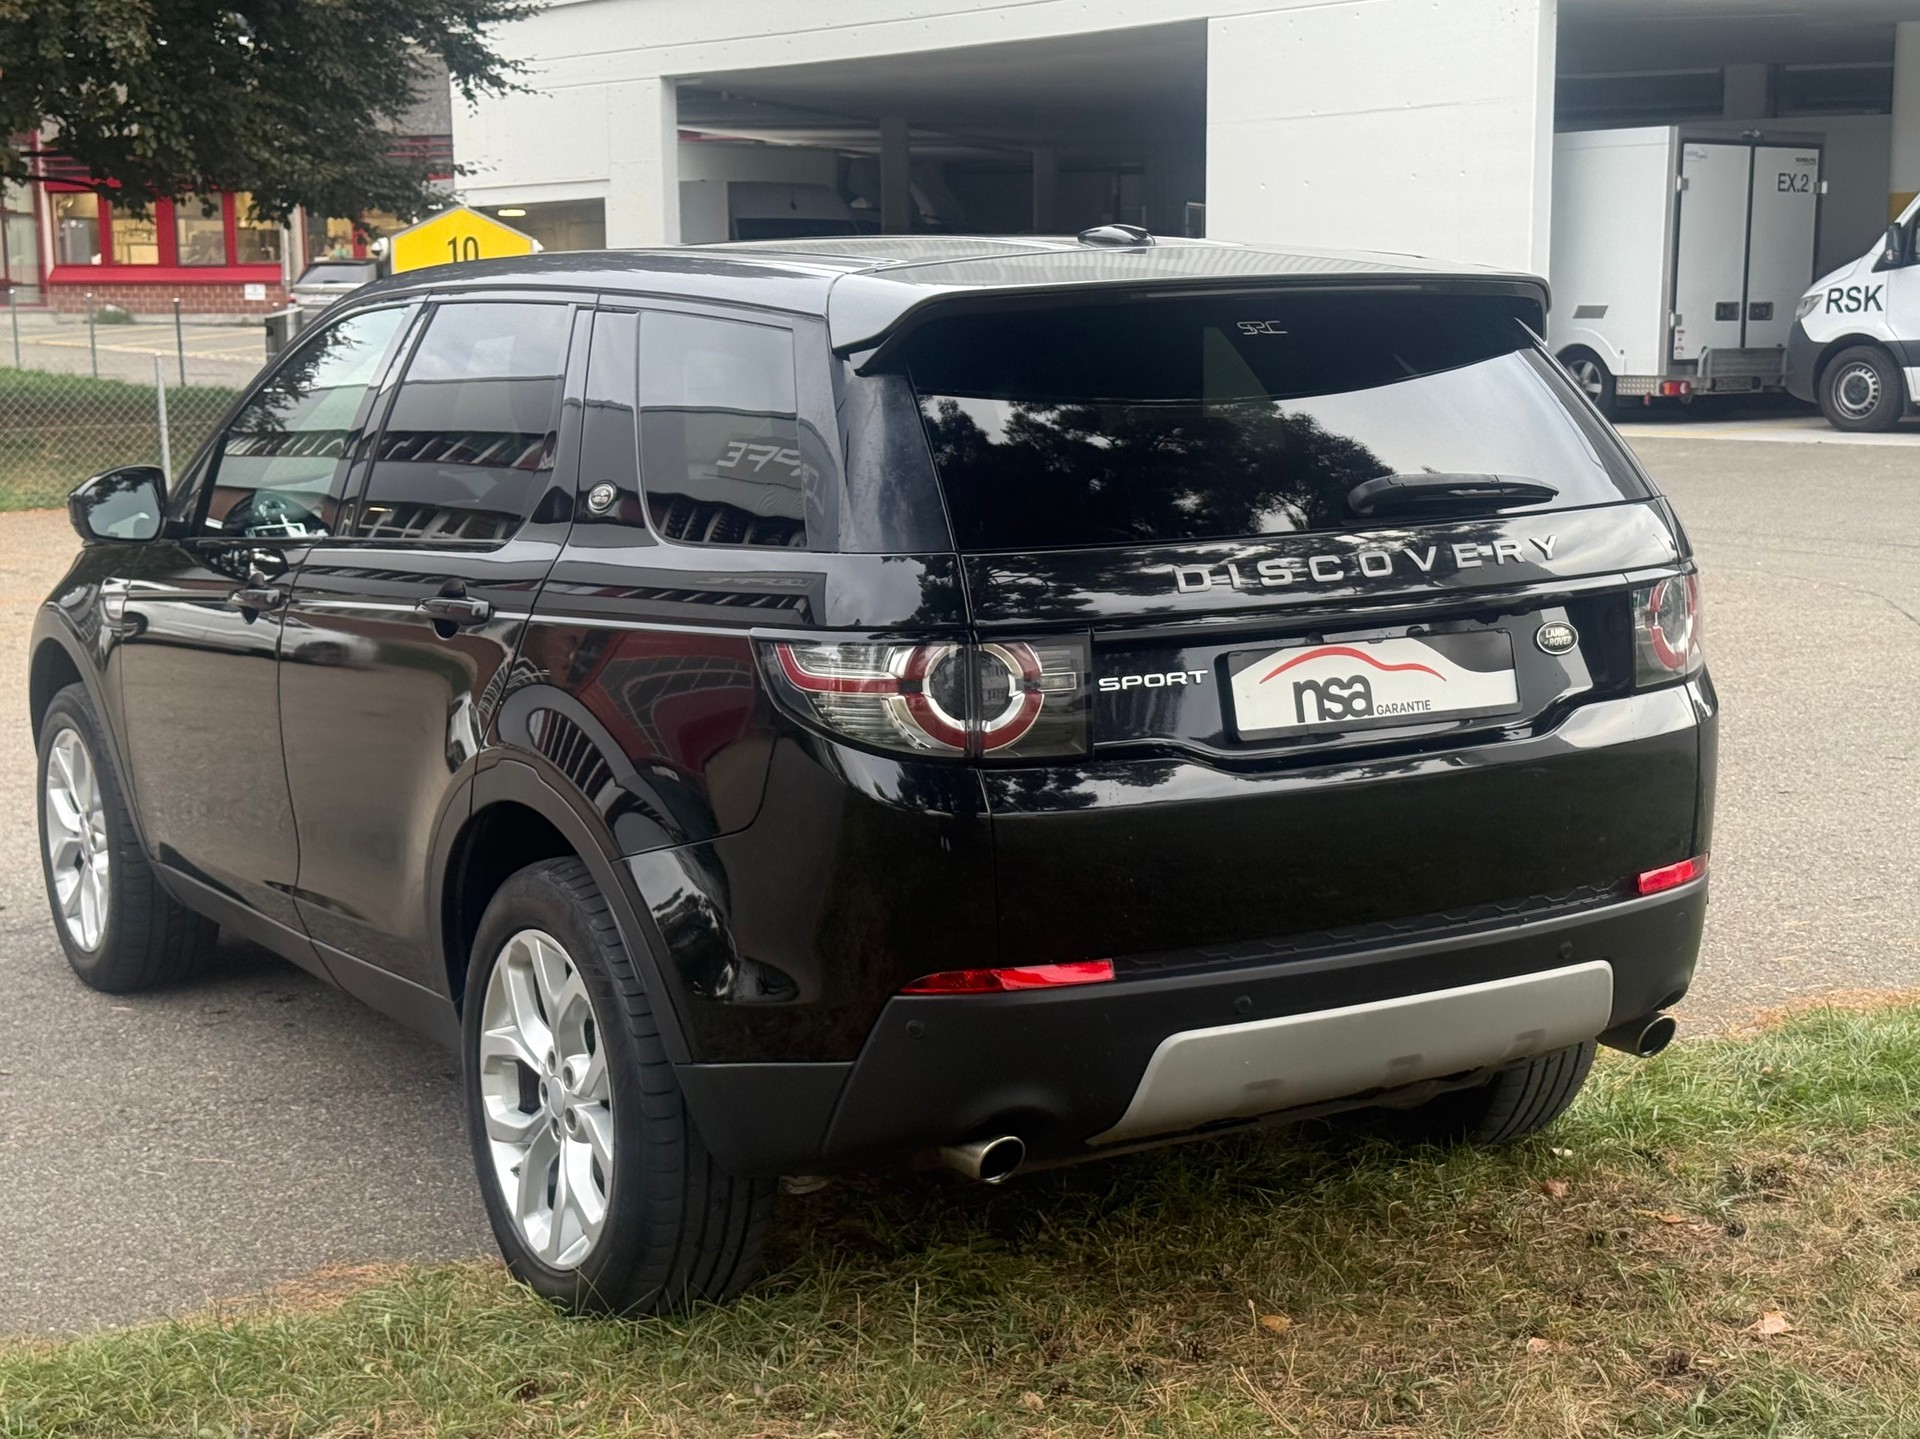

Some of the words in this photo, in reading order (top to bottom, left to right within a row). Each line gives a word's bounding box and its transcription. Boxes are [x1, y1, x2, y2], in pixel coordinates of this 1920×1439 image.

[1777, 173, 1809, 193] EX.2
[447, 235, 479, 262] 10
[1825, 284, 1884, 314] RSK
[1173, 535, 1558, 594] DISCOVERY
[1545, 627, 1566, 638] LAND
[1549, 635, 1572, 646] ROVER
[1098, 669, 1208, 692] SPORT
[1292, 675, 1375, 723] nsa
[1376, 700, 1431, 715] GARANTIE
